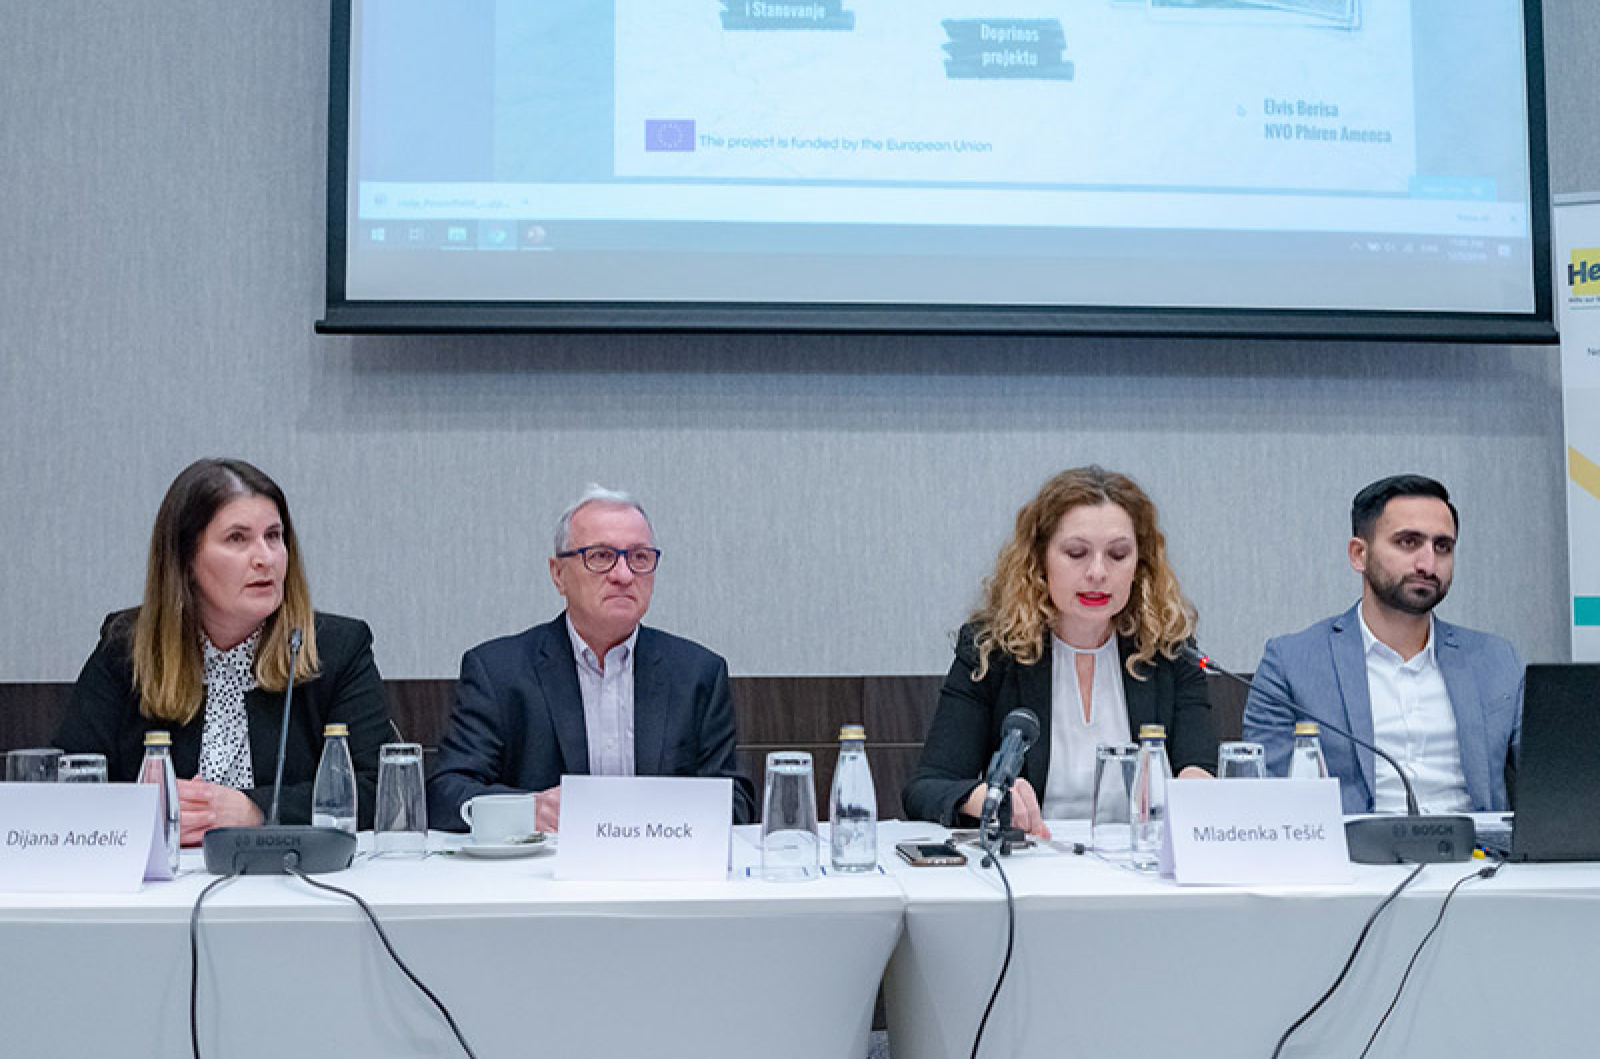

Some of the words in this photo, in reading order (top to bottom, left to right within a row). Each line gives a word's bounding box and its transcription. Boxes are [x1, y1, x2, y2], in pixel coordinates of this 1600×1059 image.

[752, 1, 825, 20] Stanovanje
[981, 23, 1039, 44] Doprinos
[981, 49, 1038, 68] projektu
[1263, 98, 1294, 115] Elvis
[1263, 123, 1293, 140] NVO
[699, 134, 725, 149] The
[727, 135, 775, 152] project
[777, 137, 789, 149] is
[791, 135, 839, 151] funded
[841, 136, 859, 153] by
[861, 138, 884, 151] the
[886, 138, 951, 154] European
[953, 139, 993, 153] Union
[596, 821, 641, 838] Klaus
[645, 821, 693, 838] Mock
[1193, 824, 1279, 841] Mladenka
[1281, 823, 1326, 841] Tešić
[1412, 824, 1453, 836] BOSCH
[6, 829, 60, 850] Dijana
[255, 834, 301, 846] BOSCH
